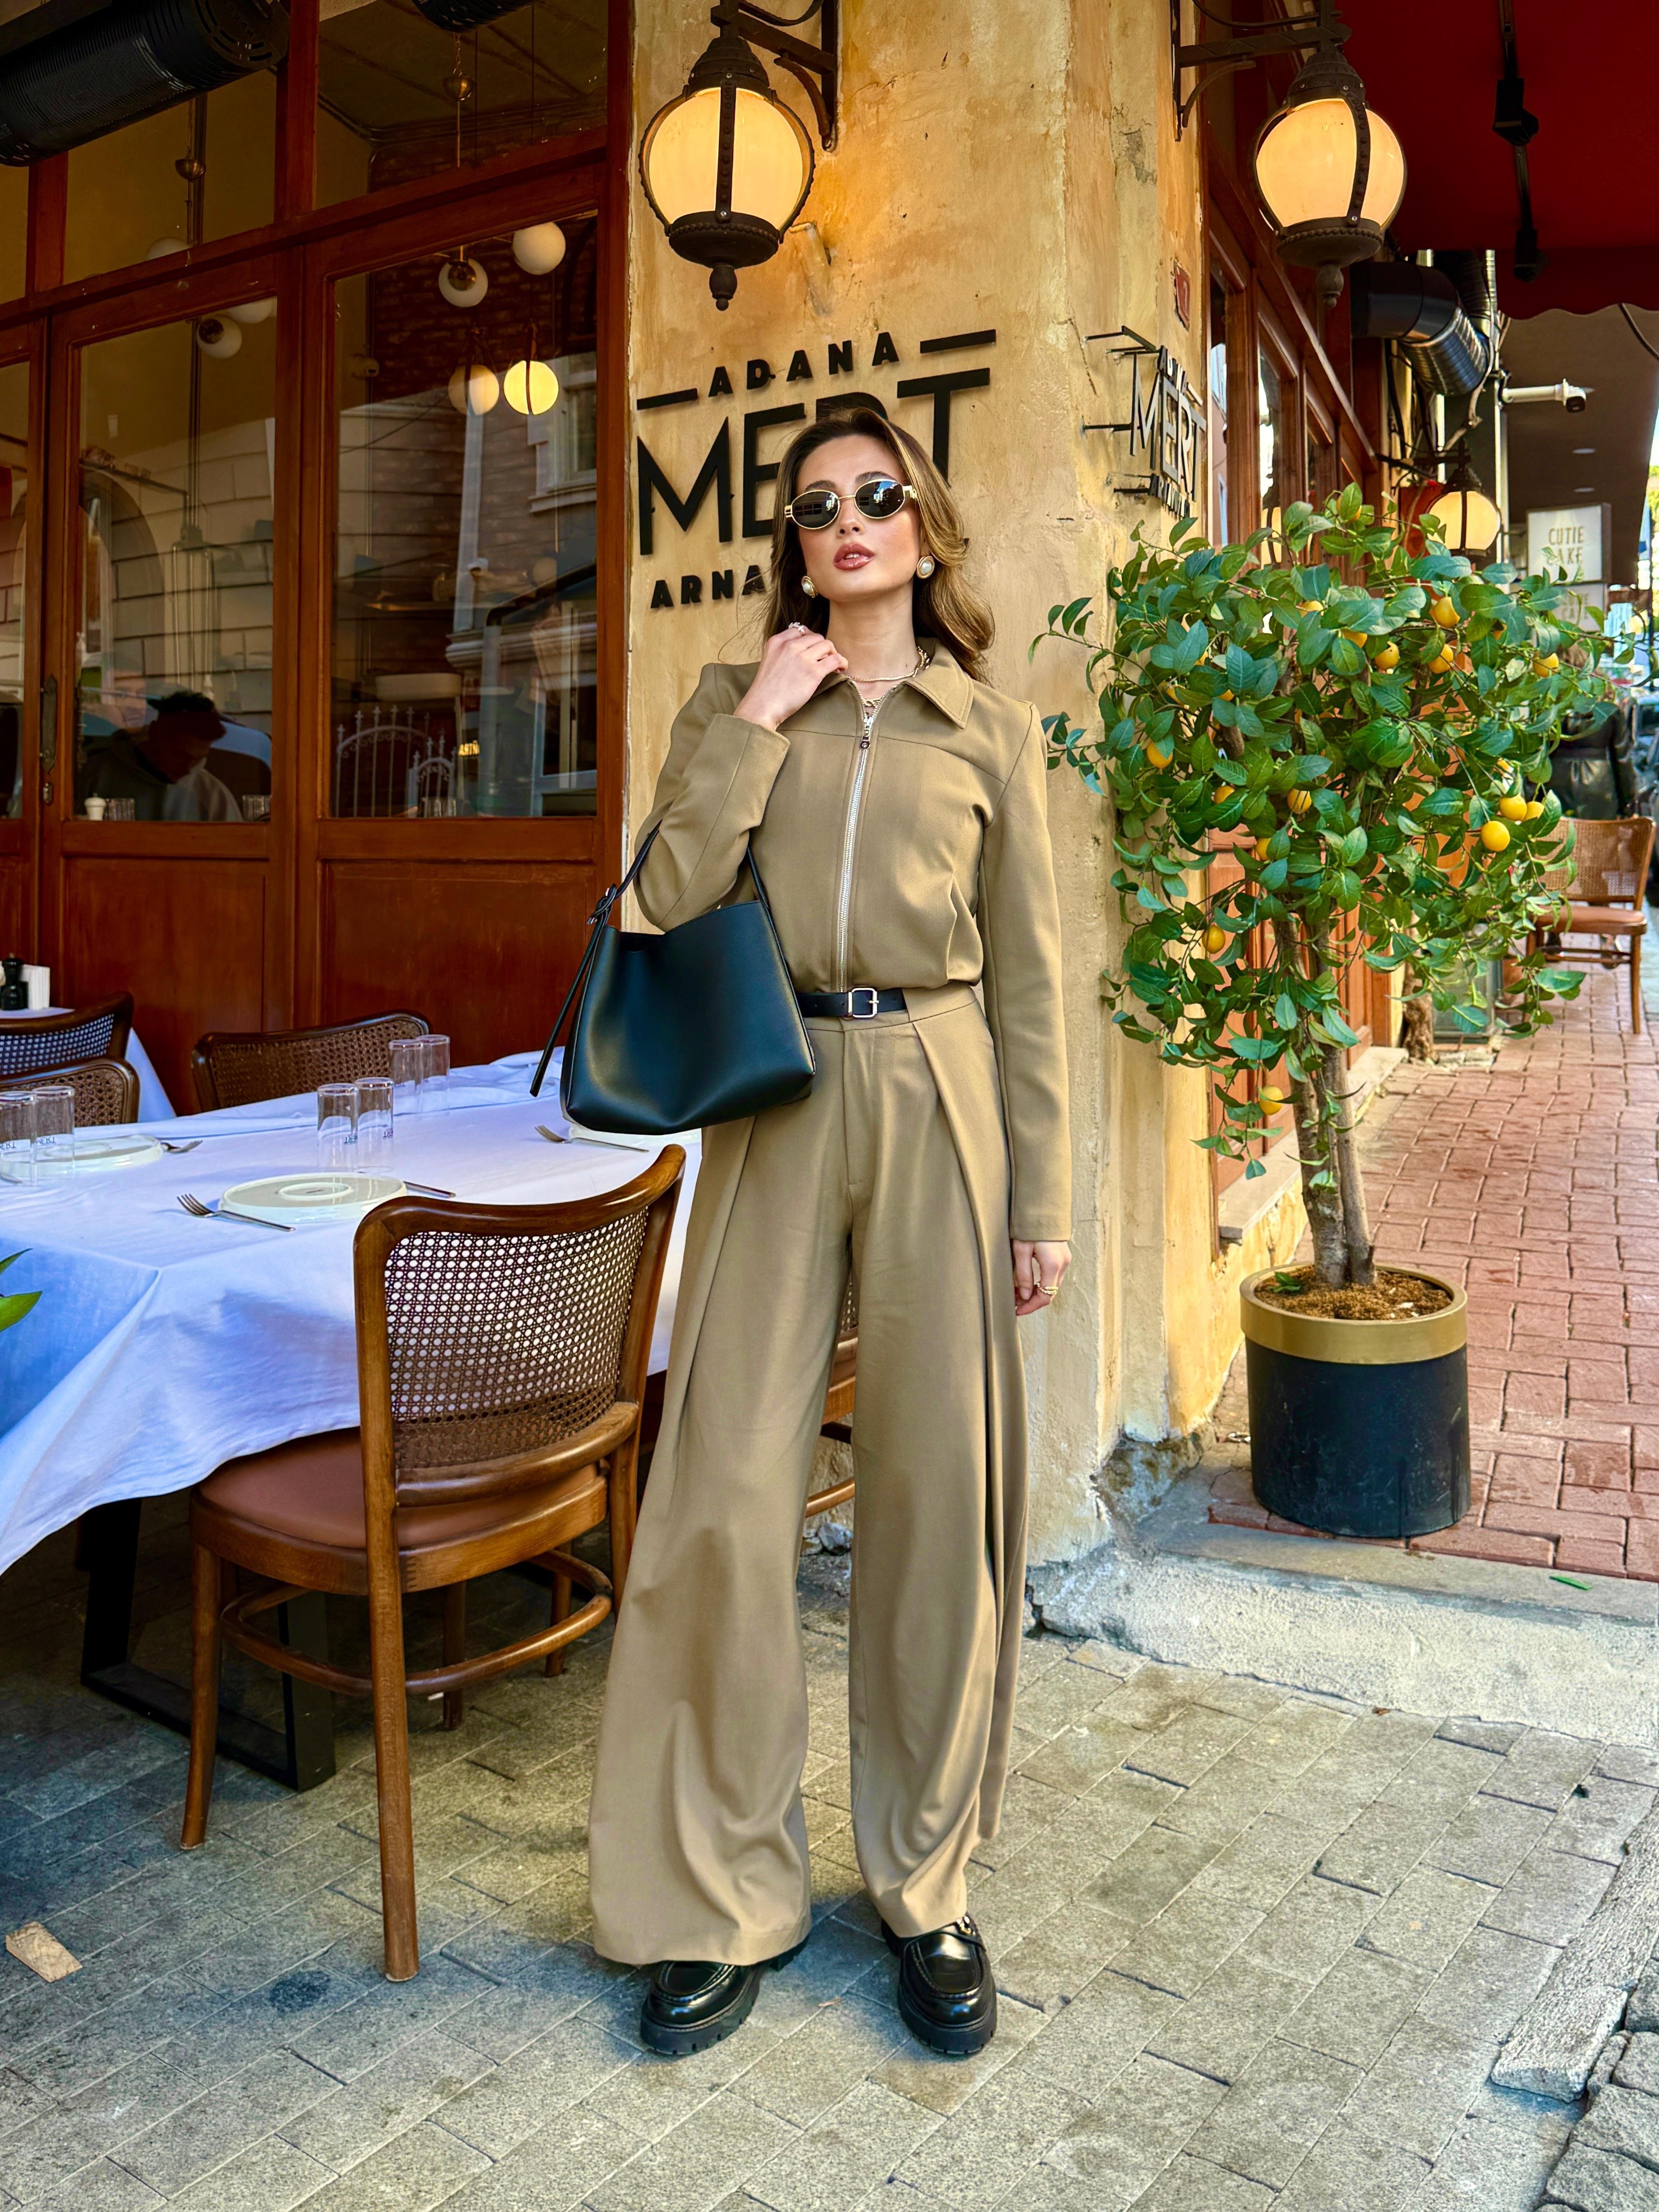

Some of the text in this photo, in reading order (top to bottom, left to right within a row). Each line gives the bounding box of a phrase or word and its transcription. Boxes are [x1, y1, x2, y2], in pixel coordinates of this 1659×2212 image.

[708, 332, 899, 397] ADANA
[637, 367, 990, 556] MET
[1130, 352, 1206, 503] MERT
[1548, 525, 1584, 545] CUTIE
